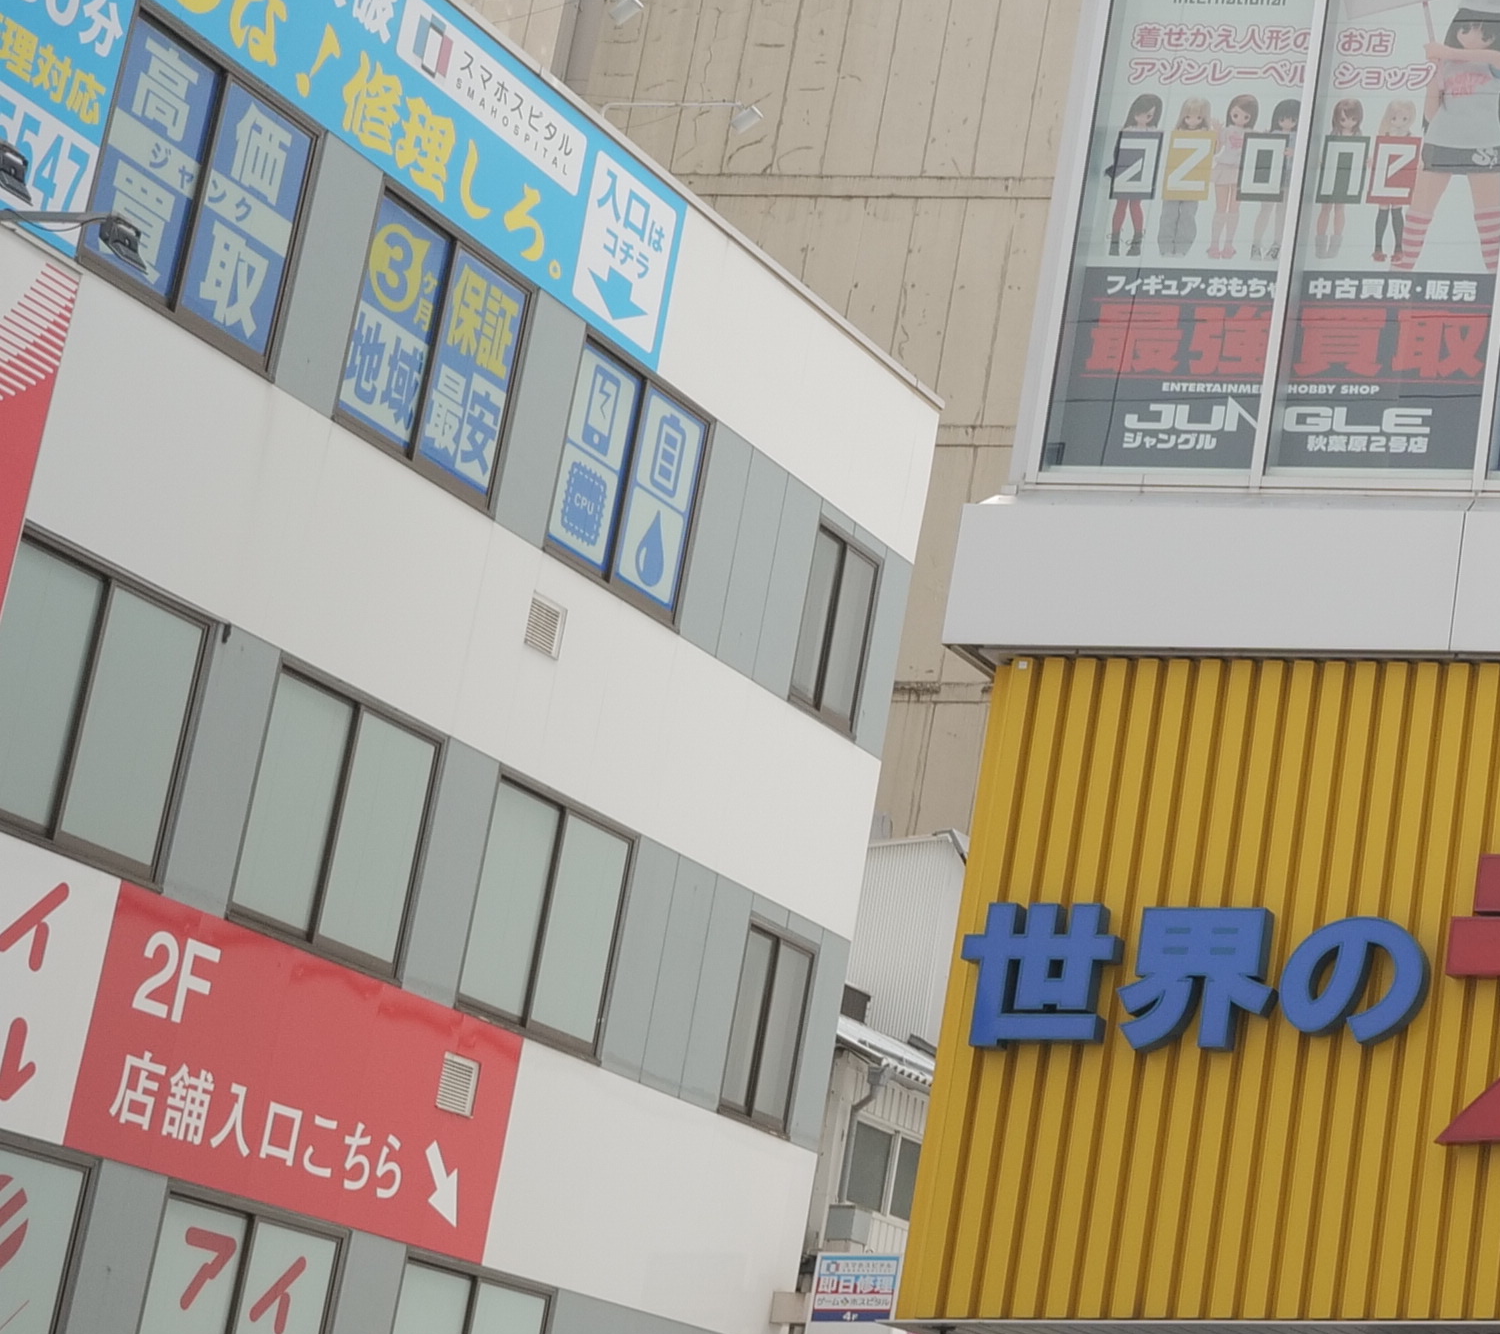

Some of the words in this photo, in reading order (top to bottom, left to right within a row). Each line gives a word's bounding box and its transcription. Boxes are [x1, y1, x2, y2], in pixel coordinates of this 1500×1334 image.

[132, 36, 293, 206] 高価
[455, 77, 569, 176] SMAHOSPITAL
[459, 50, 574, 158] スマホスピタル
[148, 140, 253, 223] ジャンク
[1108, 130, 1423, 206] azone
[111, 159, 270, 339] 買取
[596, 168, 666, 254] 入口は
[602, 227, 651, 280] コチラ
[1307, 278, 1478, 302] 中古買取・販売
[446, 264, 519, 380] 保証
[1084, 303, 1492, 380] 最強買取
[342, 311, 425, 433] 地域
[426, 364, 499, 478] 最安
[1123, 396, 1433, 435] JUNGLE
[1286, 384, 1337, 395] HOBBY
[1340, 384, 1381, 395] SHOP
[1122, 433, 1217, 451] ジャングル
[1306, 435, 1428, 454] 秋葉原2号店
[573, 490, 596, 516] CPU
[131, 930, 223, 1025] 2F
[960, 900, 1431, 1054] 世界の
[109, 1051, 403, 1201] 店舗入口こちら
[816, 1275, 894, 1295] 即日修理
[842, 1311, 859, 1321] 4F
